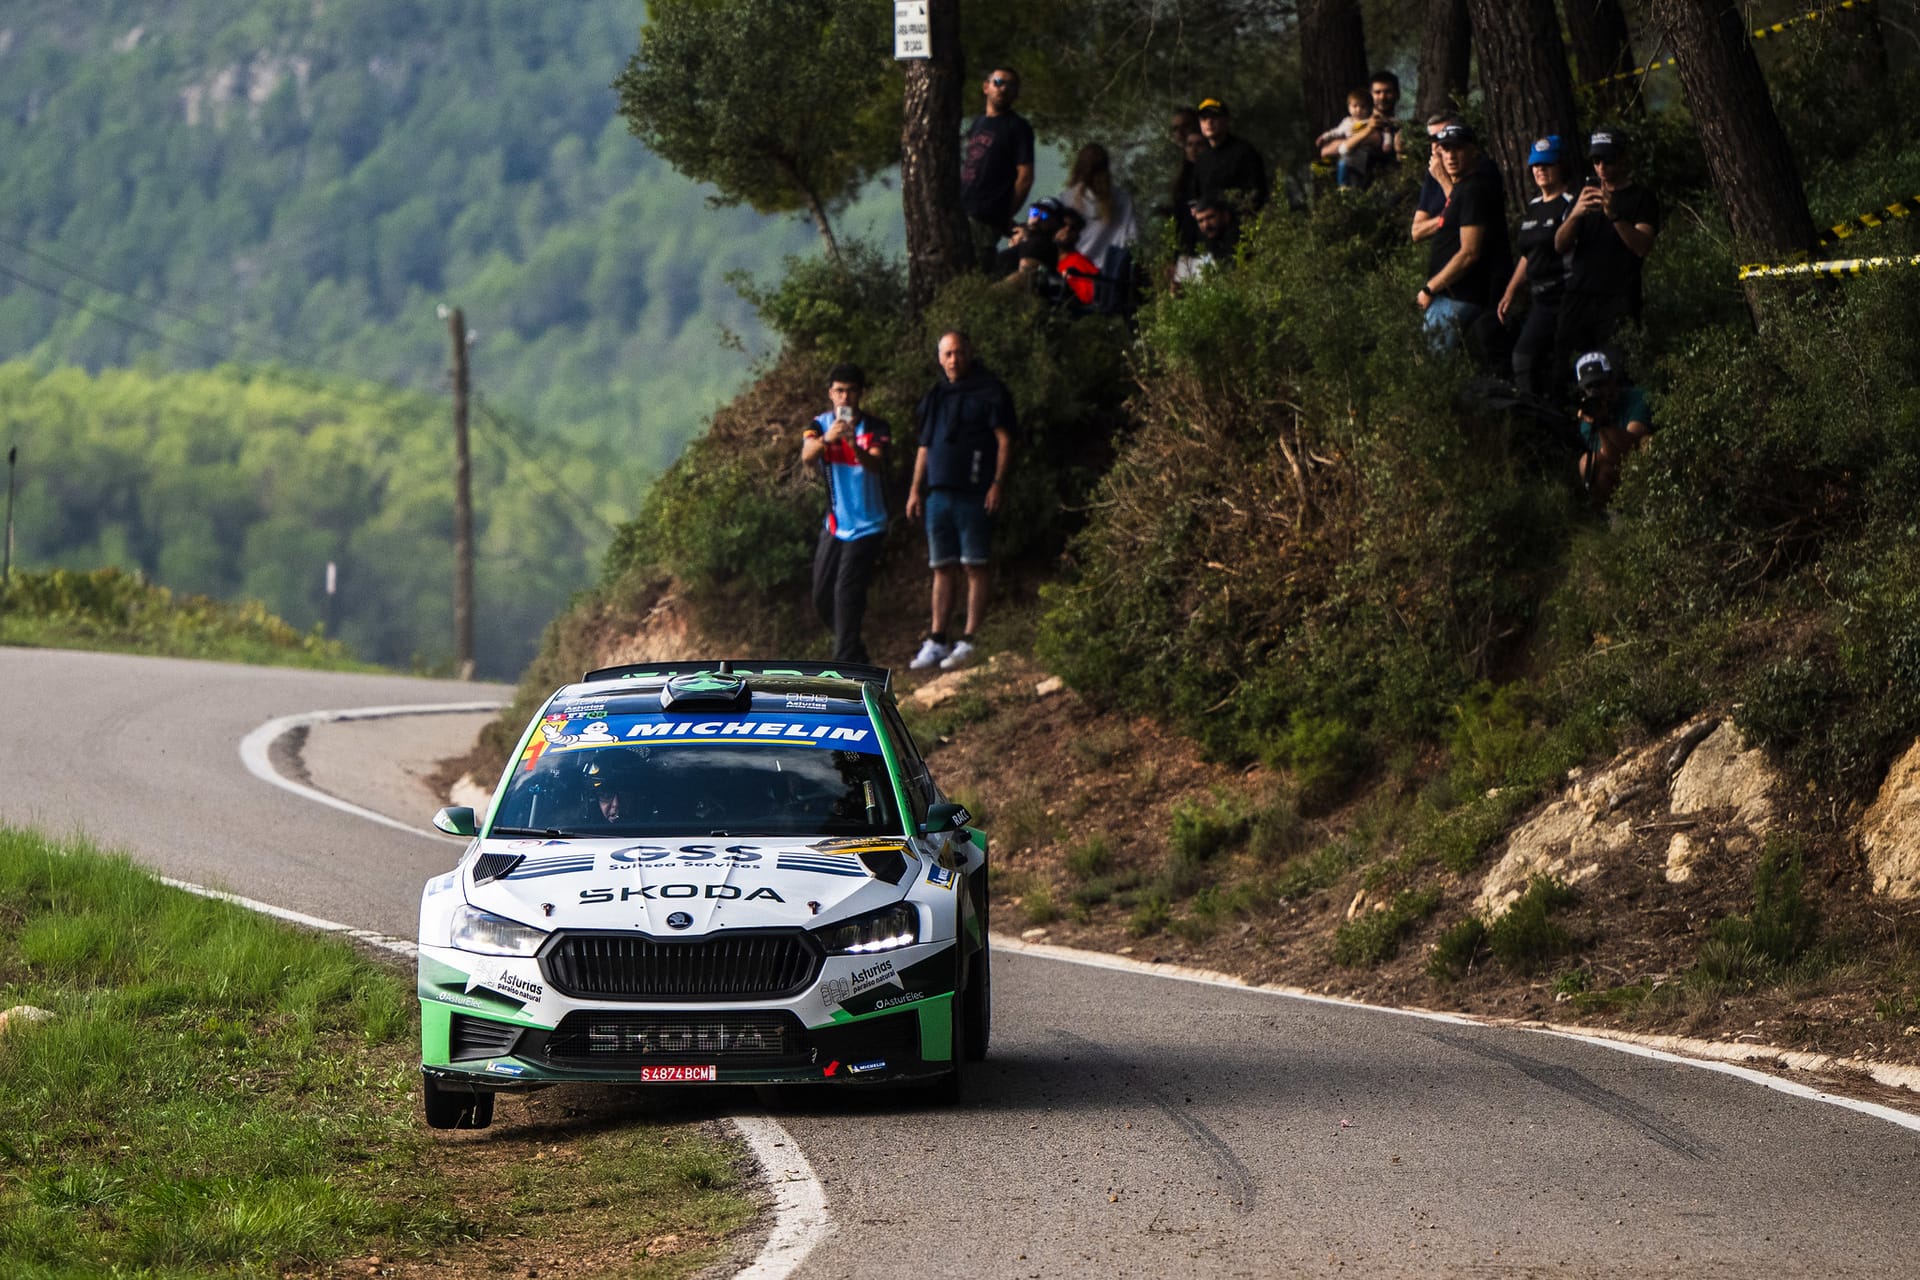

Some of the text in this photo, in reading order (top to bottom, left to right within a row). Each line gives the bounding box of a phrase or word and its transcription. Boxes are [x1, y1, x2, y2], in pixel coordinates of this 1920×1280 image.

[626, 722, 868, 742] MICHELIN
[524, 741, 546, 771] 1
[610, 845, 763, 863] GSS
[683, 861, 761, 869] Services
[579, 884, 786, 905] SKODA
[499, 969, 543, 995] Asturias
[851, 959, 893, 986] Asturias
[875, 969, 896, 984] natural
[519, 990, 542, 1003] natural
